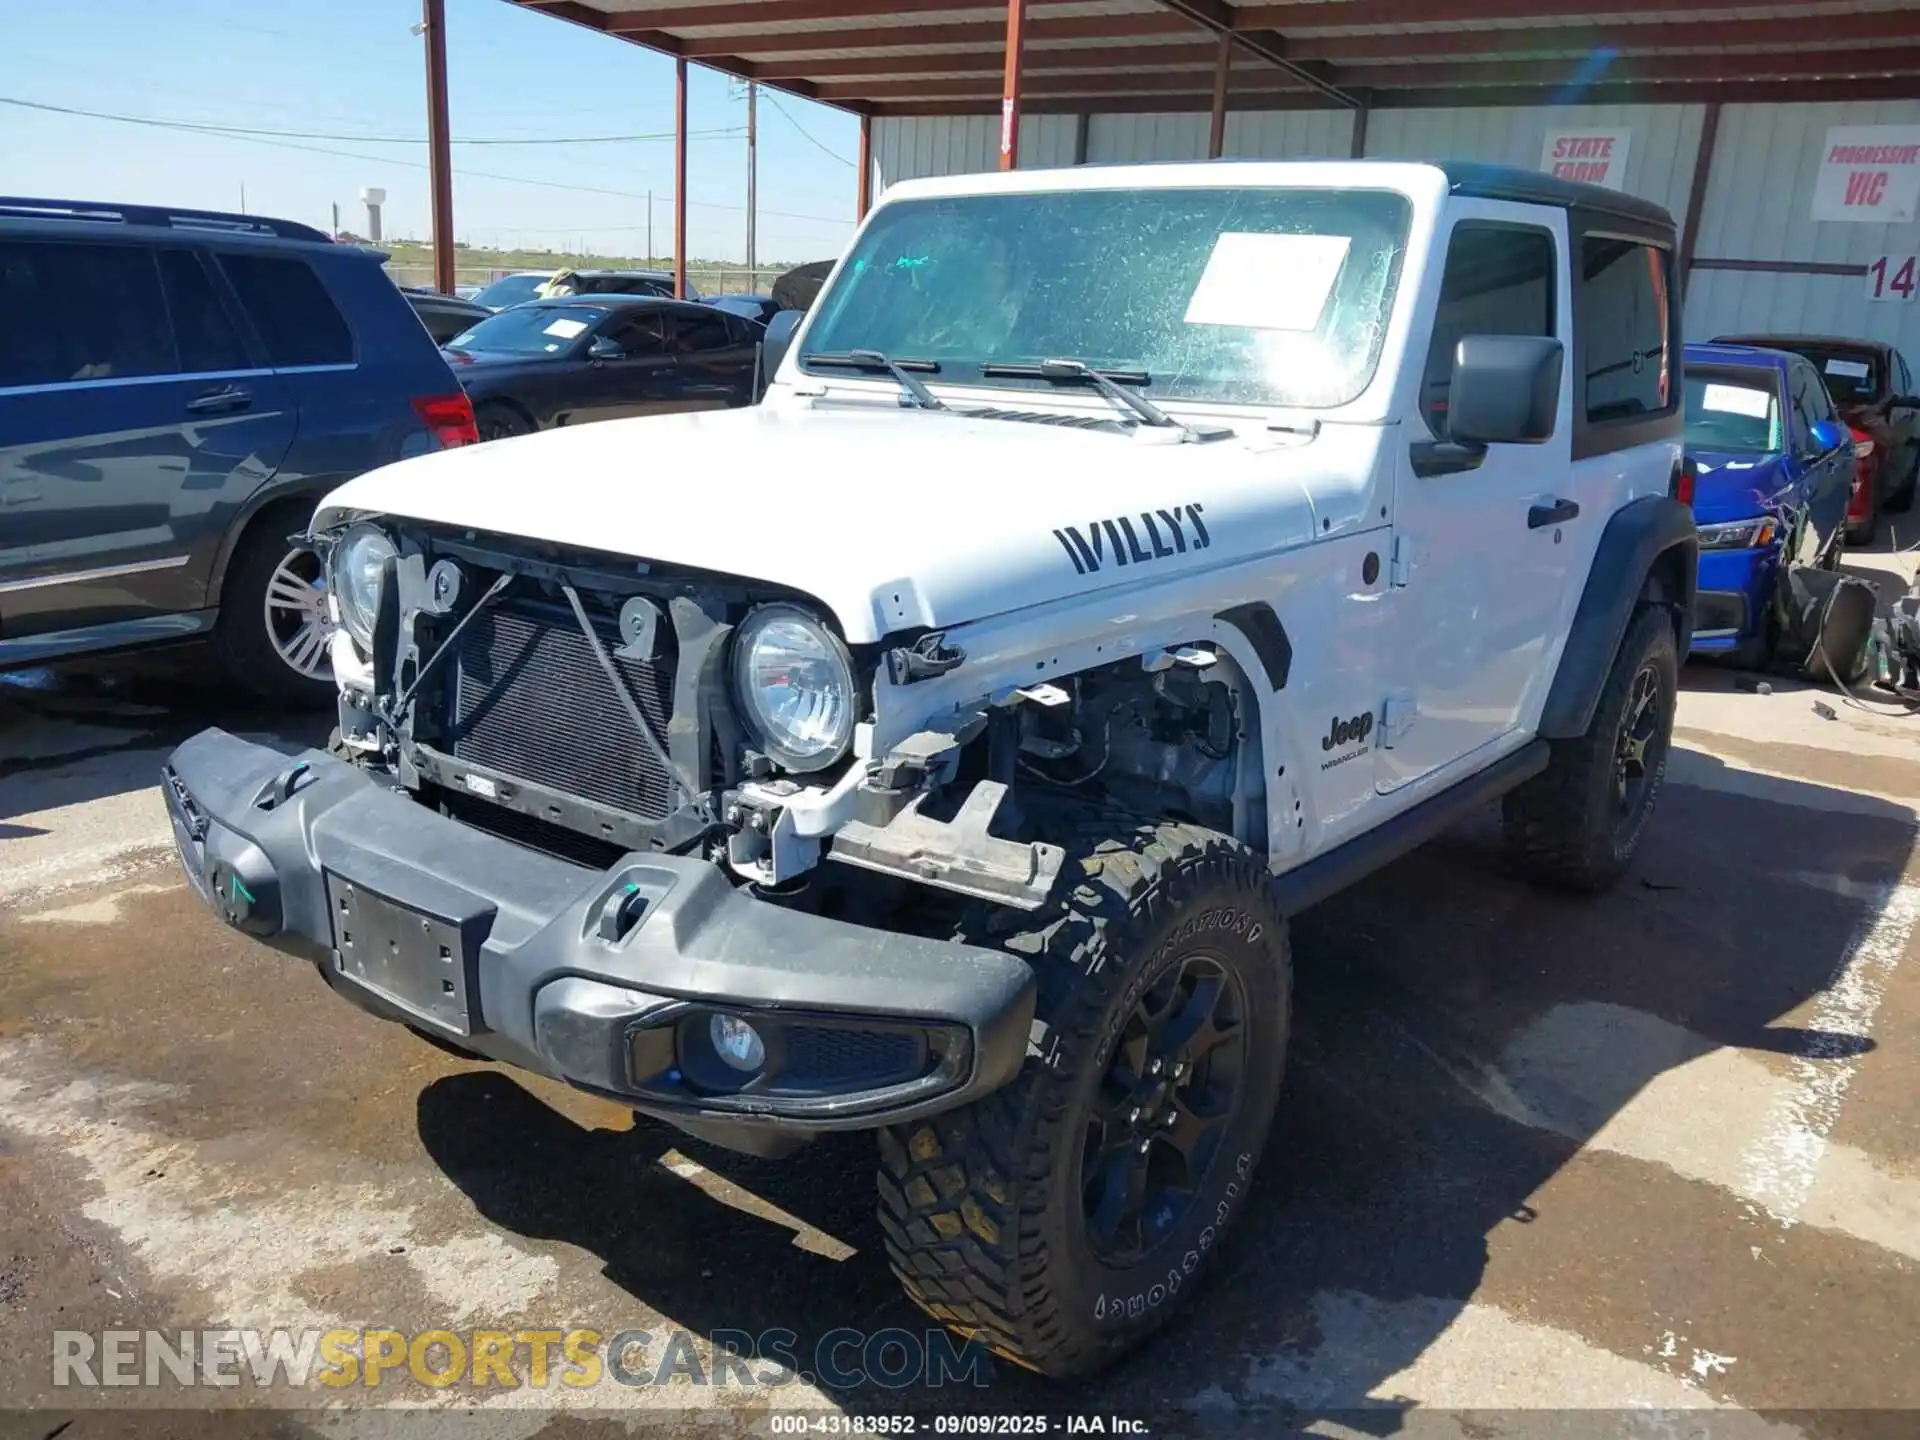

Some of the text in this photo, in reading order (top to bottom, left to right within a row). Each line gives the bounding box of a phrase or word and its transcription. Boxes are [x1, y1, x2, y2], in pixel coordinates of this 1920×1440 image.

[1552, 137, 1616, 158] STATE
[1828, 145, 1920, 165] PROGRESSIVE
[1552, 162, 1609, 183] FARM
[1844, 171, 1888, 206] VIC
[1871, 256, 1916, 299] 14
[1052, 503, 1210, 574] WILLYS
[1322, 711, 1373, 751] Jeep
[1321, 746, 1369, 771] WRANGLER
